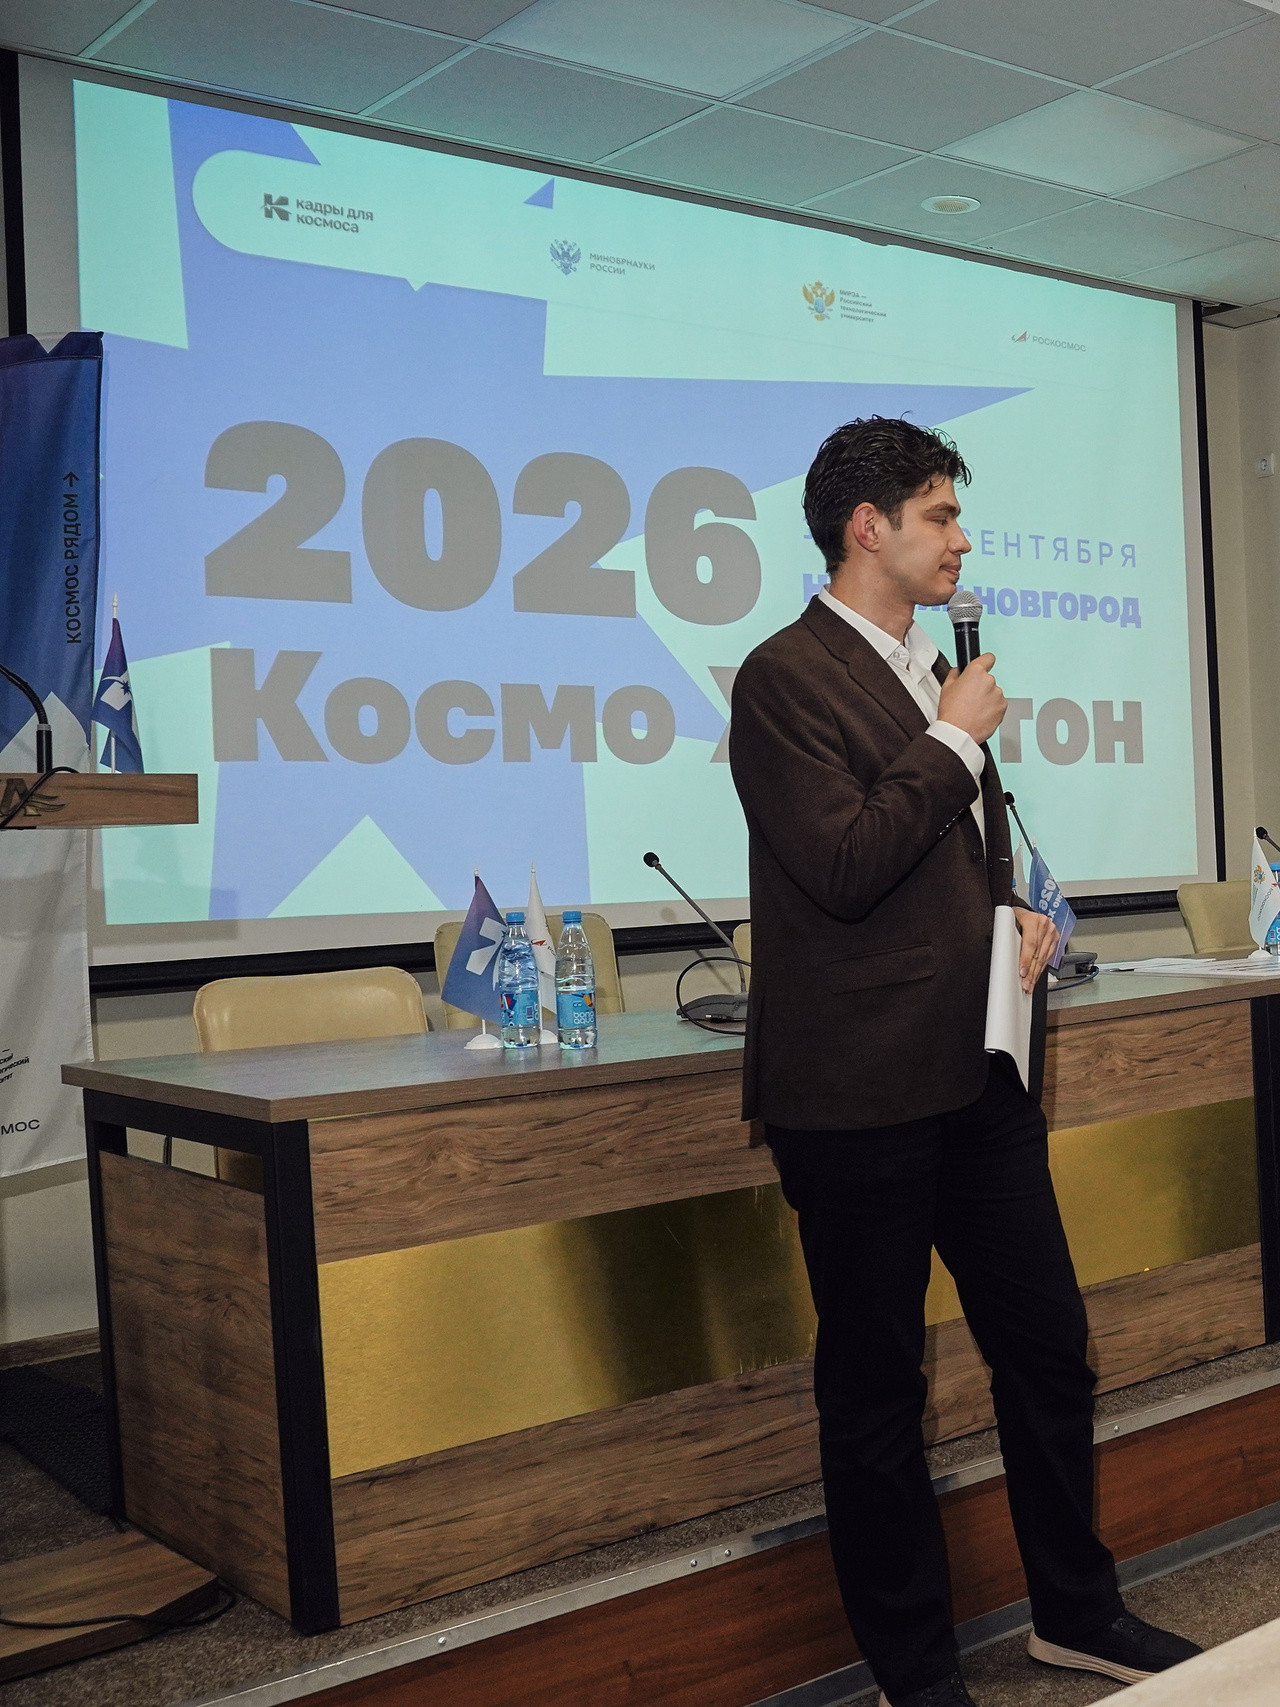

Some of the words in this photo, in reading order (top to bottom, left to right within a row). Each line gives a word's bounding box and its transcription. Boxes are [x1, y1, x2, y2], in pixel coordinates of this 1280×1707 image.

[296, 199, 344, 216] кадры
[347, 207, 374, 221] для
[296, 214, 359, 233] космоса
[589, 253, 655, 271] МИНОБРНАУКИ
[590, 263, 626, 275] РОССИИ
[1032, 335, 1087, 352] РОСКОСМОС
[63, 493, 81, 559] РЯДОМ
[204, 420, 762, 626] 2026
[965, 527, 1137, 568] ЕНТЯБРЯ
[64, 564, 82, 643] КОСМОС
[210, 647, 676, 766] Космо
